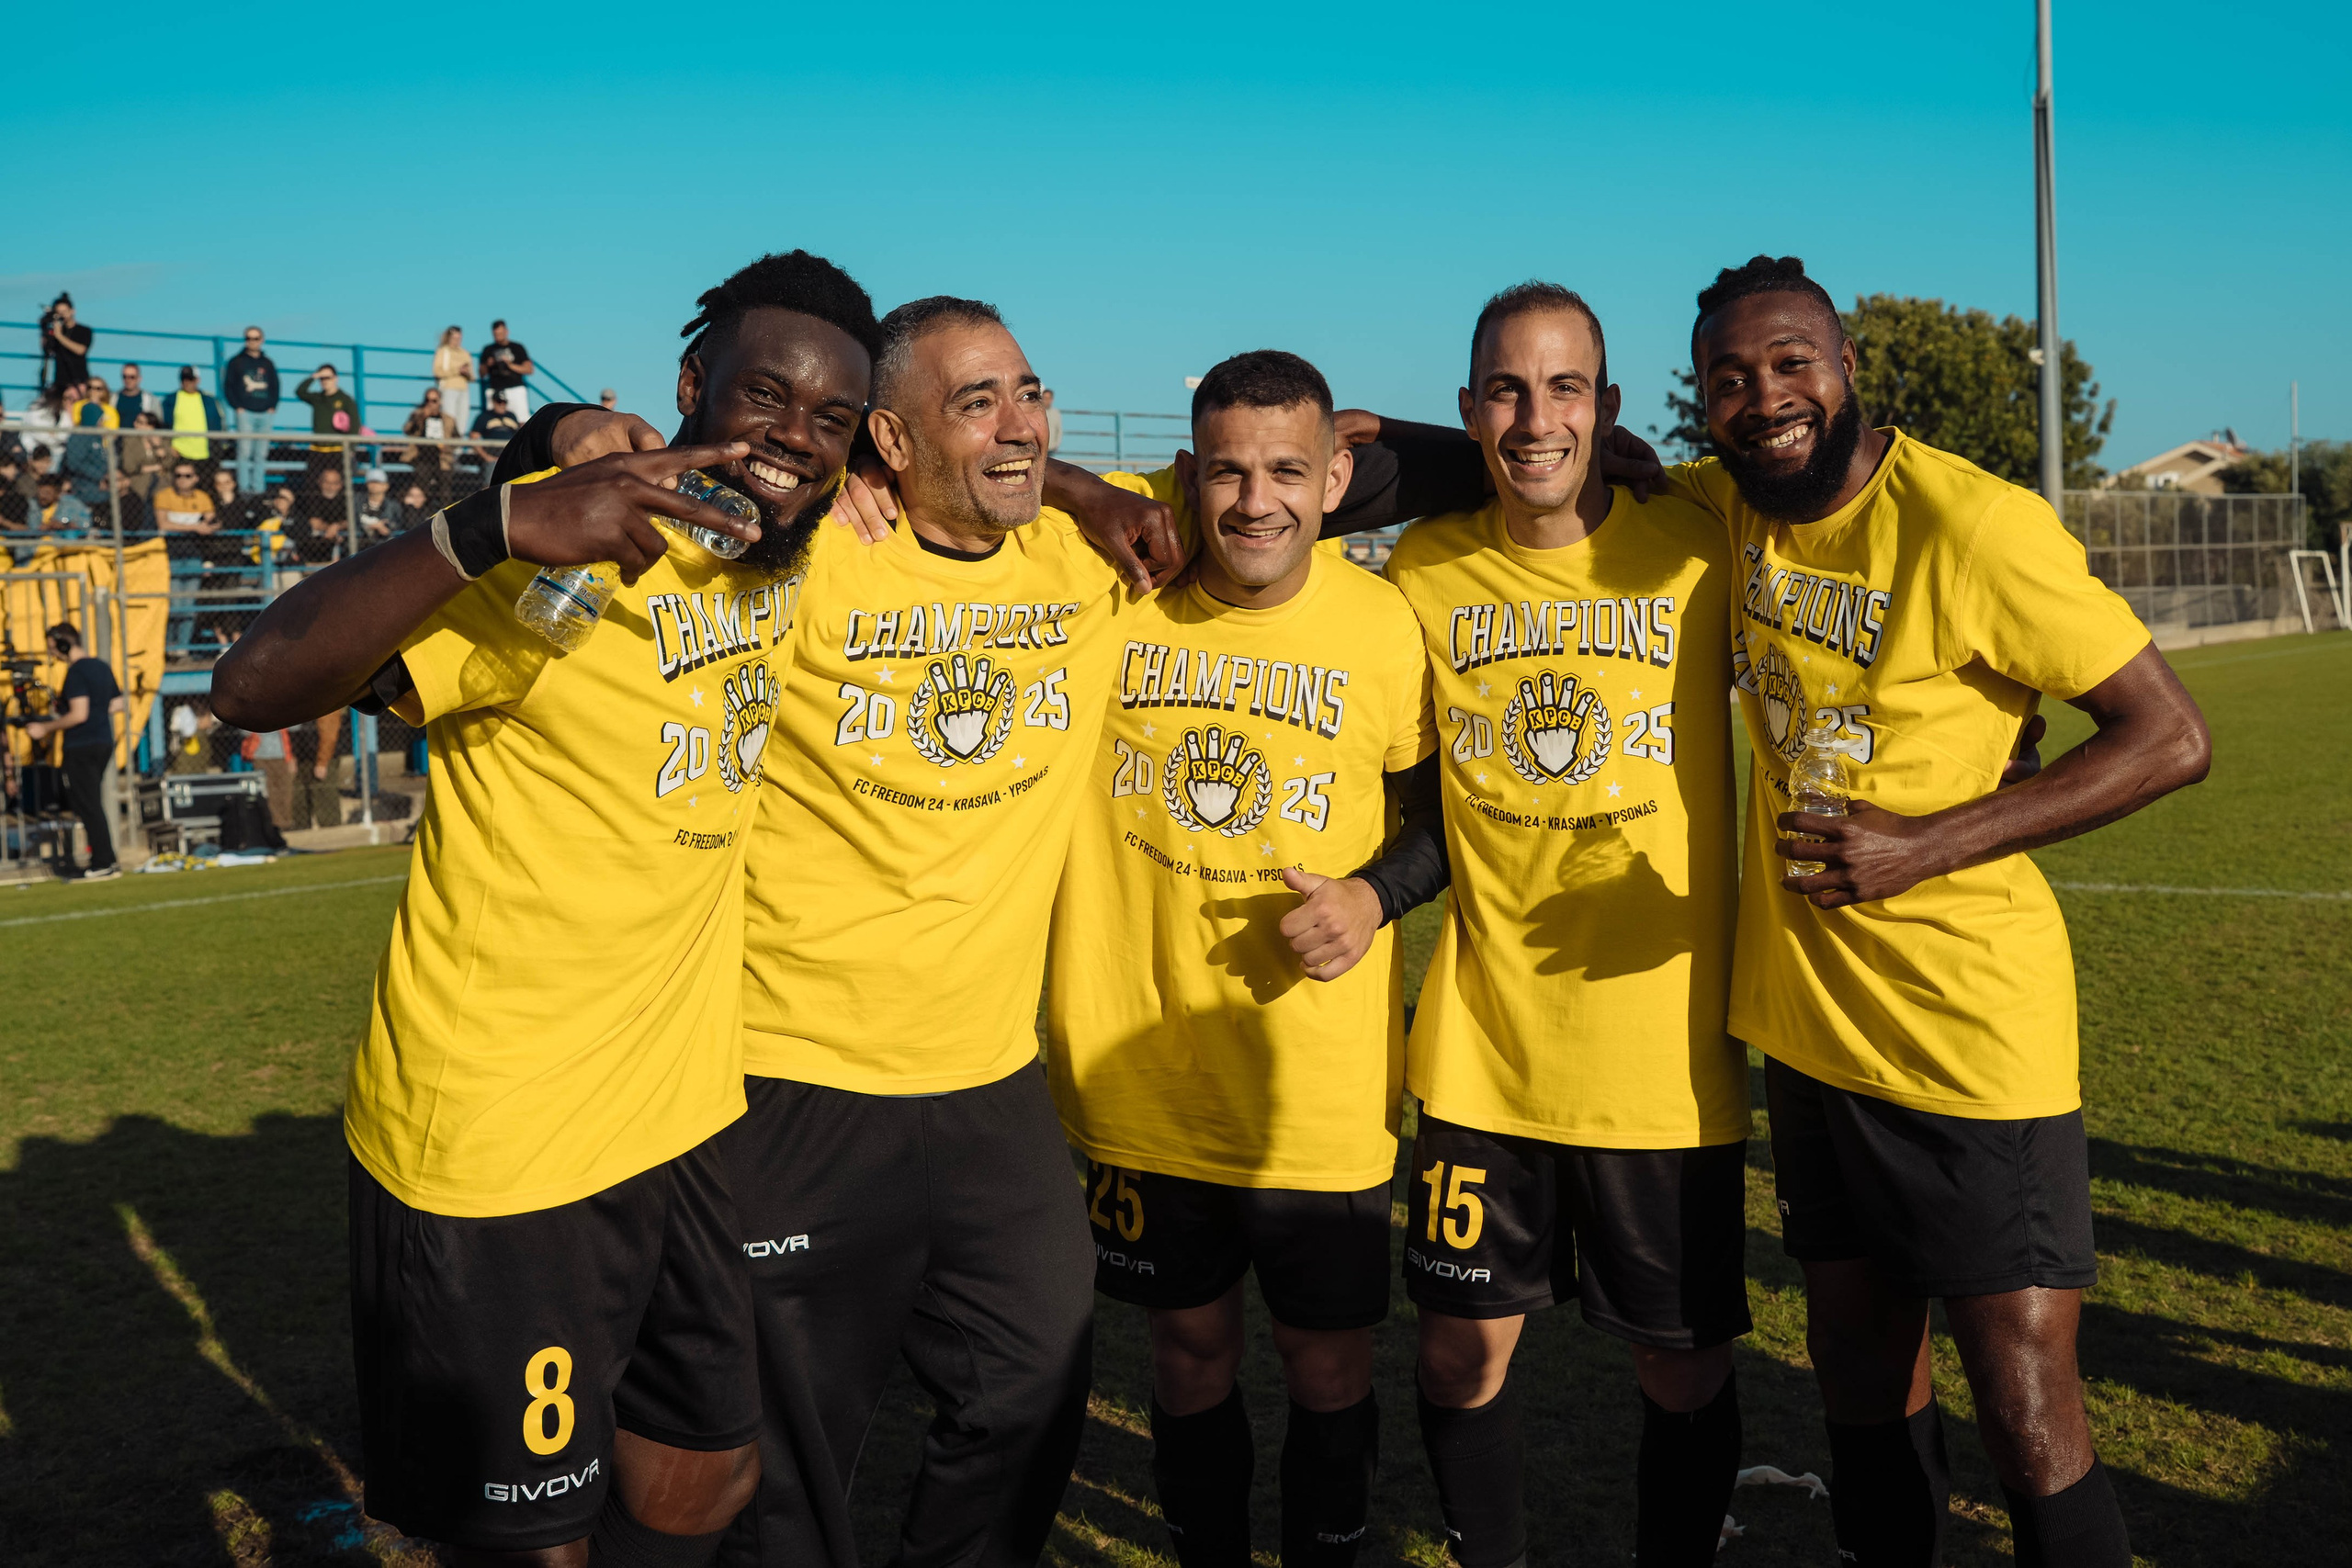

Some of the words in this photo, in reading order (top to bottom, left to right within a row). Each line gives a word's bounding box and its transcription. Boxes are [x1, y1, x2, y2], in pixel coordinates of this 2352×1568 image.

[842, 602, 1081, 661] CHAMPIONS
[1449, 597, 1676, 675] CHAMPIONS
[834, 682, 896, 746] 20
[1023, 667, 1071, 731] 25
[1119, 640, 1349, 740] CHAMPIONS
[656, 721, 711, 798] 20
[1448, 706, 1494, 766] 20
[1622, 701, 1676, 766] 25
[853, 778, 868, 795] FC
[870, 784, 925, 810] FREEDOM
[928, 797, 944, 811] 24
[953, 791, 1001, 812] KRASAVA
[1009, 766, 1049, 798] YPSONAS
[1112, 739, 1155, 798] 20
[1279, 772, 1336, 832] 25
[1465, 794, 1480, 807] FC
[1477, 801, 1521, 826] FREEDOM
[1524, 815, 1540, 829] 24
[1548, 815, 1597, 830] KRASAVA
[1605, 799, 1658, 826] YPSONAS
[673, 829, 690, 846] FC
[688, 832, 727, 850] FREEDOM
[1125, 831, 1137, 847] FC
[1137, 840, 1175, 872] FREEDOM
[1176, 861, 1191, 875] 24
[1199, 865, 1247, 883] KRASAVA
[1256, 863, 1304, 882] YPSOS
[1089, 1160, 1145, 1242] 25
[1422, 1160, 1487, 1249] 15
[1095, 1243, 1155, 1275] IVOVA
[1408, 1247, 1491, 1283] GIVOVA
[523, 1346, 575, 1456] 8
[484, 1458, 600, 1502] GIVOVA
